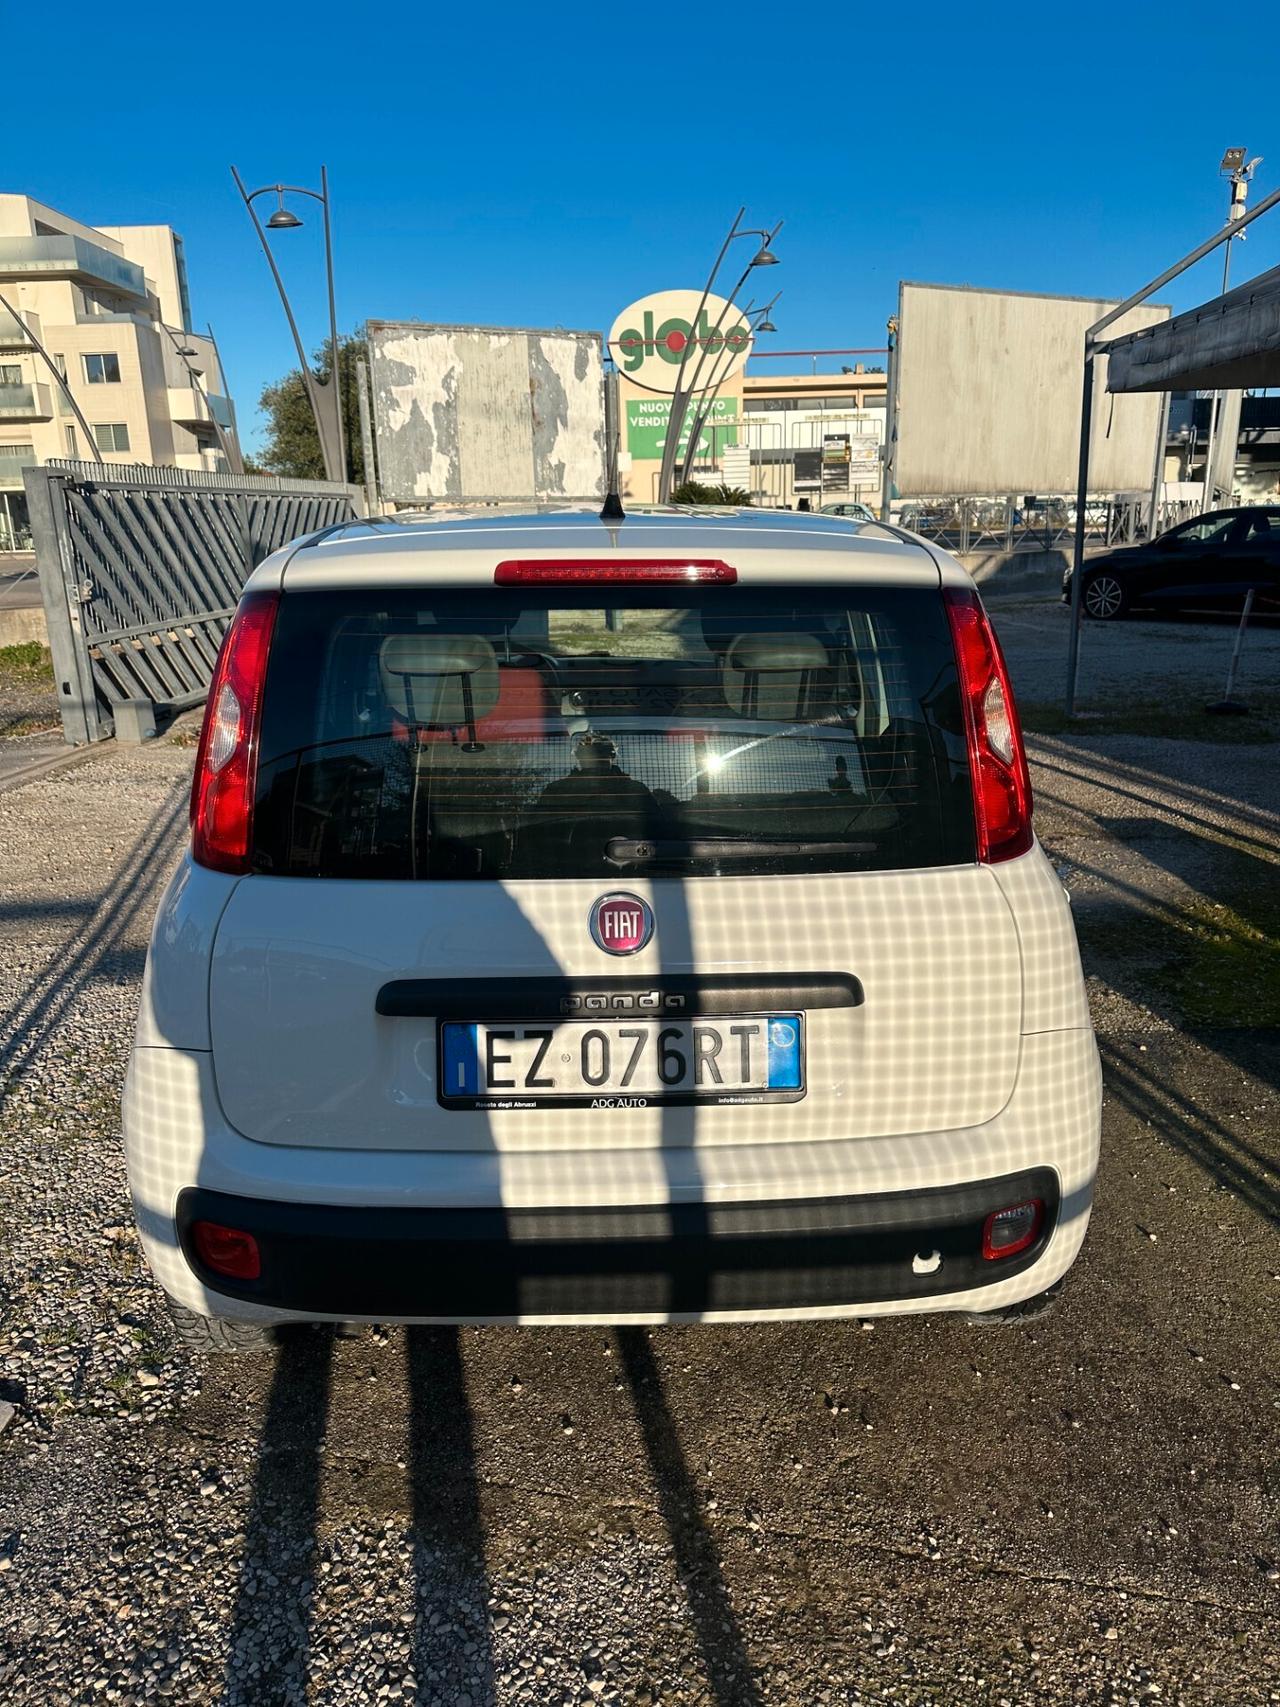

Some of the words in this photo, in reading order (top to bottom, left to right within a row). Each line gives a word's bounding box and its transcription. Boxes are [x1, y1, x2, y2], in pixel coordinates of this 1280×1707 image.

[619, 309, 750, 372] globo
[639, 402, 674, 413] NUOV
[604, 911, 641, 939] FIAT
[560, 991, 686, 1013] panda
[486, 1030, 555, 1088] EZ
[581, 1024, 761, 1088] 076RT
[591, 1099, 615, 1108] ADG
[617, 1098, 648, 1108] AUTO
